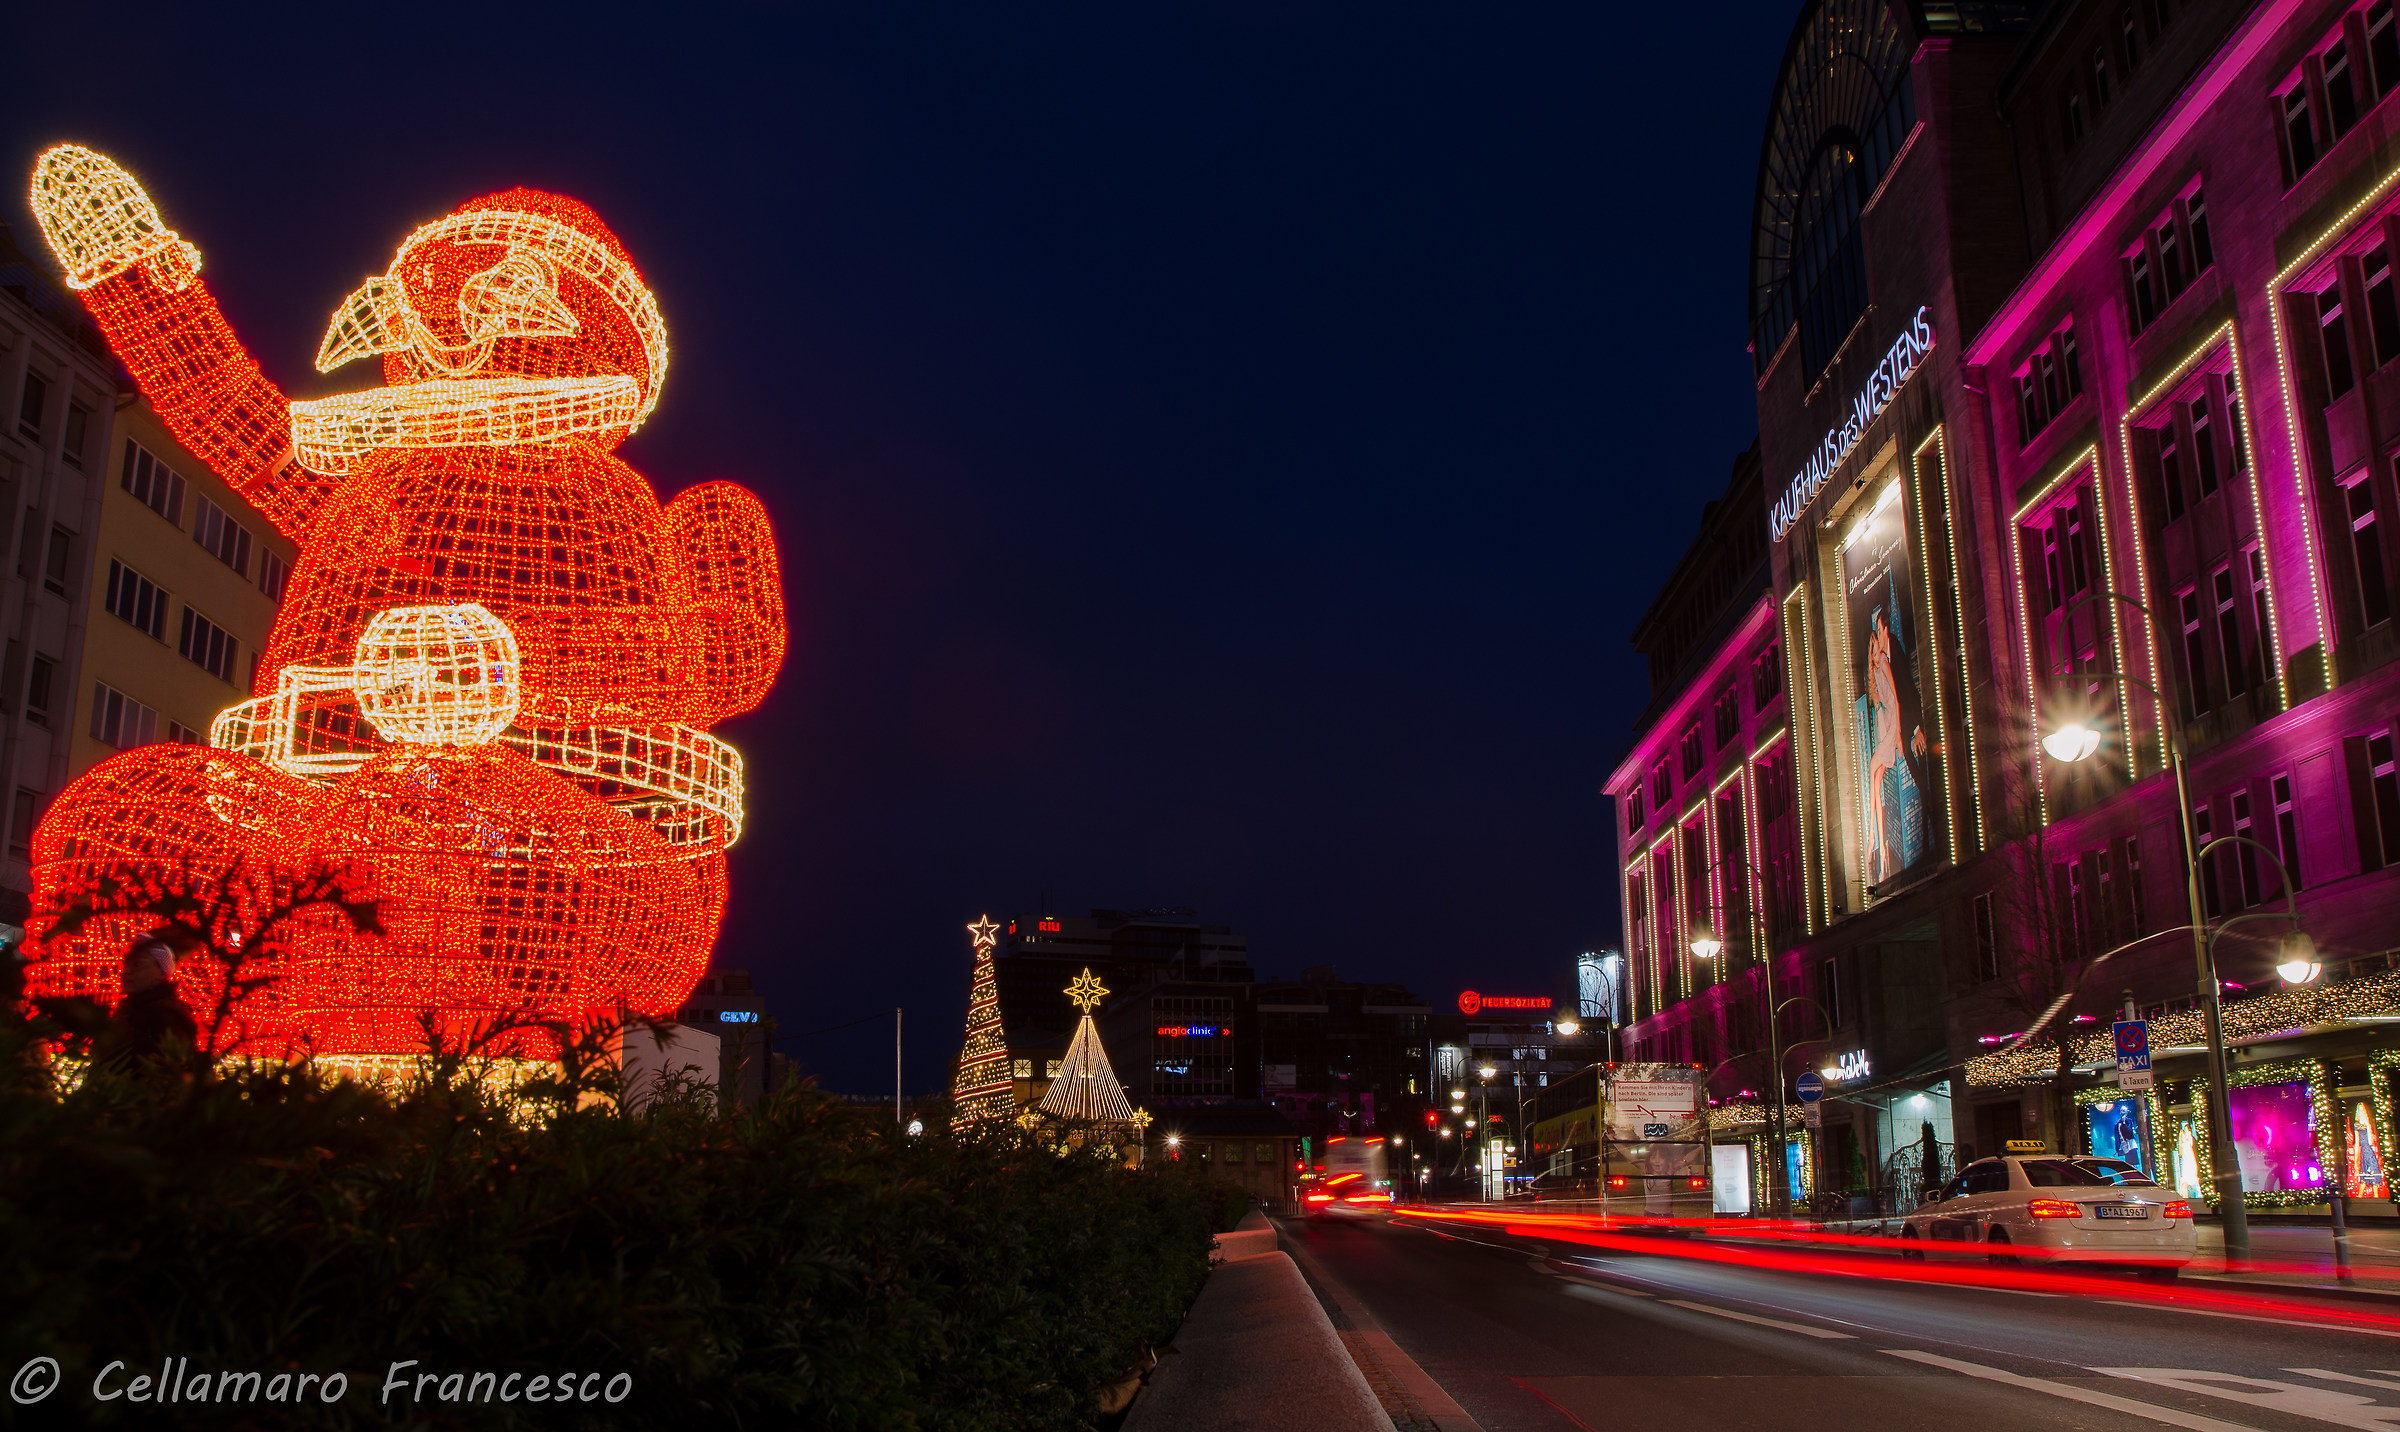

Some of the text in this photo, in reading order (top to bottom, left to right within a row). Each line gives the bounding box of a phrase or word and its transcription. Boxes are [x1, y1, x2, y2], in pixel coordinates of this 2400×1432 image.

[1770, 305, 1932, 538] KAUFHAUS DES WESTENS
[1840, 1048, 1871, 1080] KaDeWe
[2122, 1077, 2149, 1086] 4 Taxen
